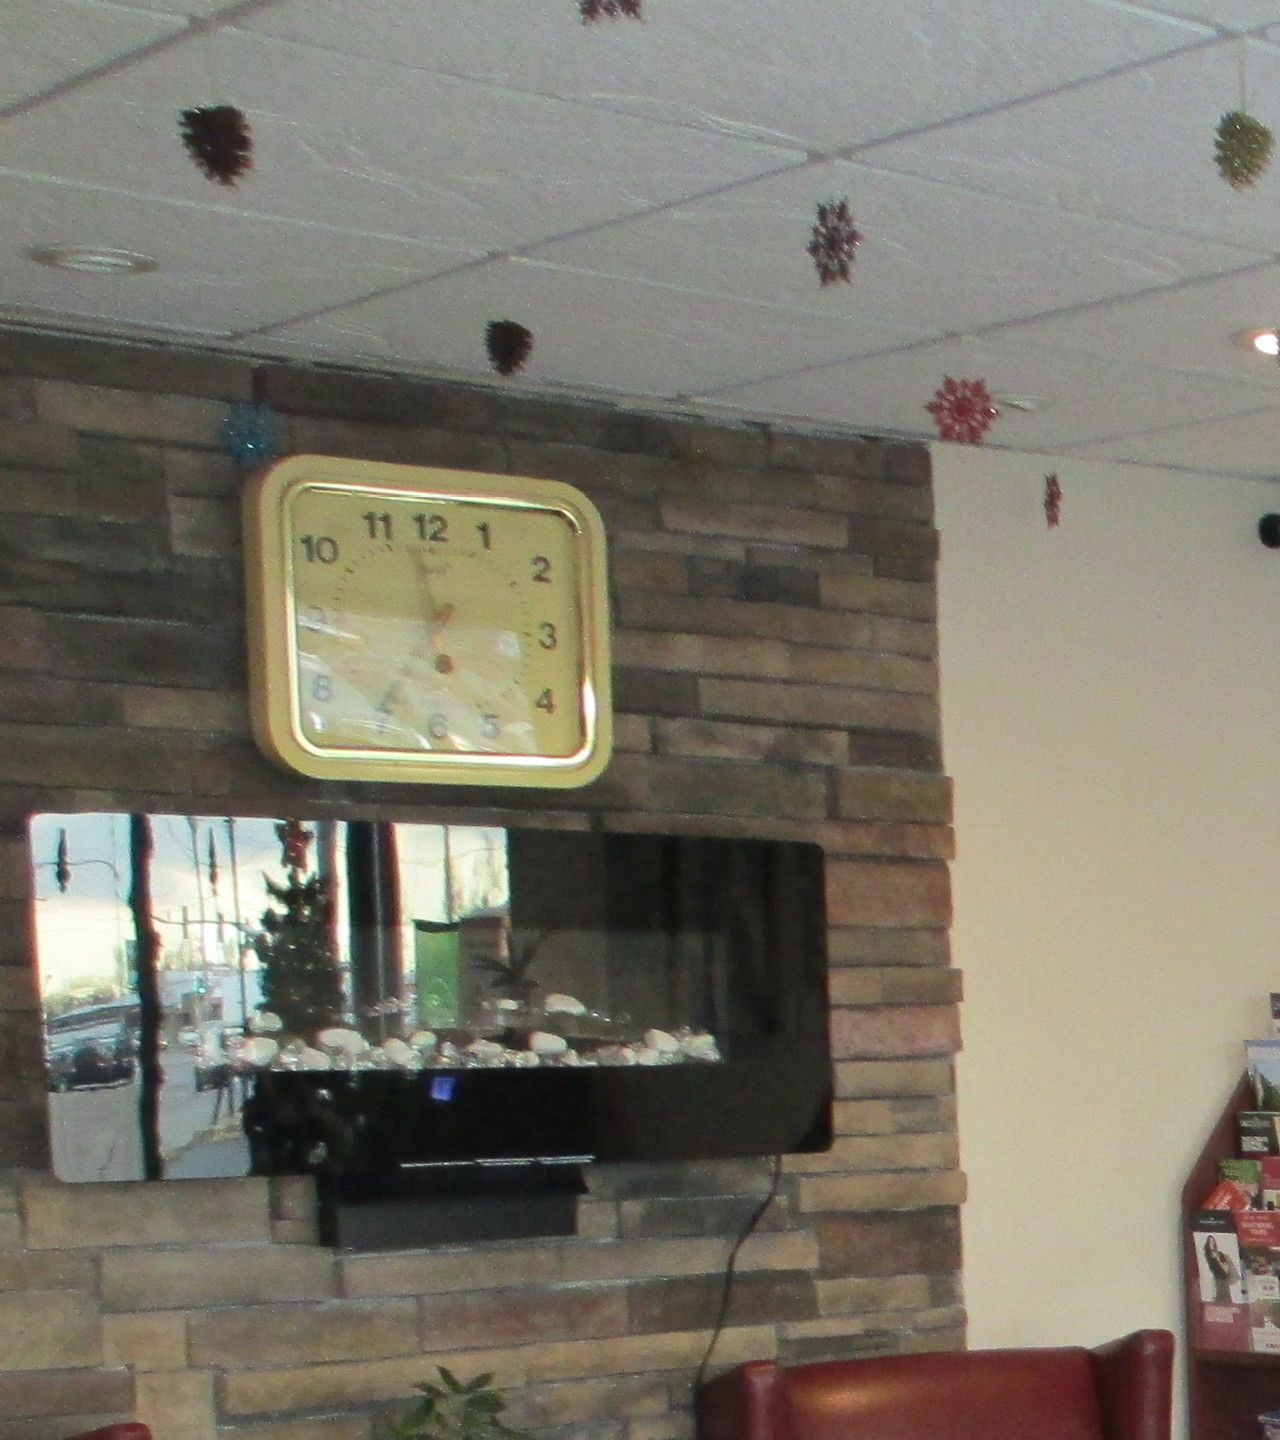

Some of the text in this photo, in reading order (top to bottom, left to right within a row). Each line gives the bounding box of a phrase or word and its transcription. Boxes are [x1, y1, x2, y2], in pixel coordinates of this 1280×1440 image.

[362, 511, 394, 541] 11
[412, 512, 449, 543] 12
[476, 522, 492, 550] 1
[299, 534, 340, 565] 10
[531, 556, 552, 583] 2
[538, 622, 558, 650] 3
[312, 675, 333, 701] 8
[535, 688, 556, 714] 4
